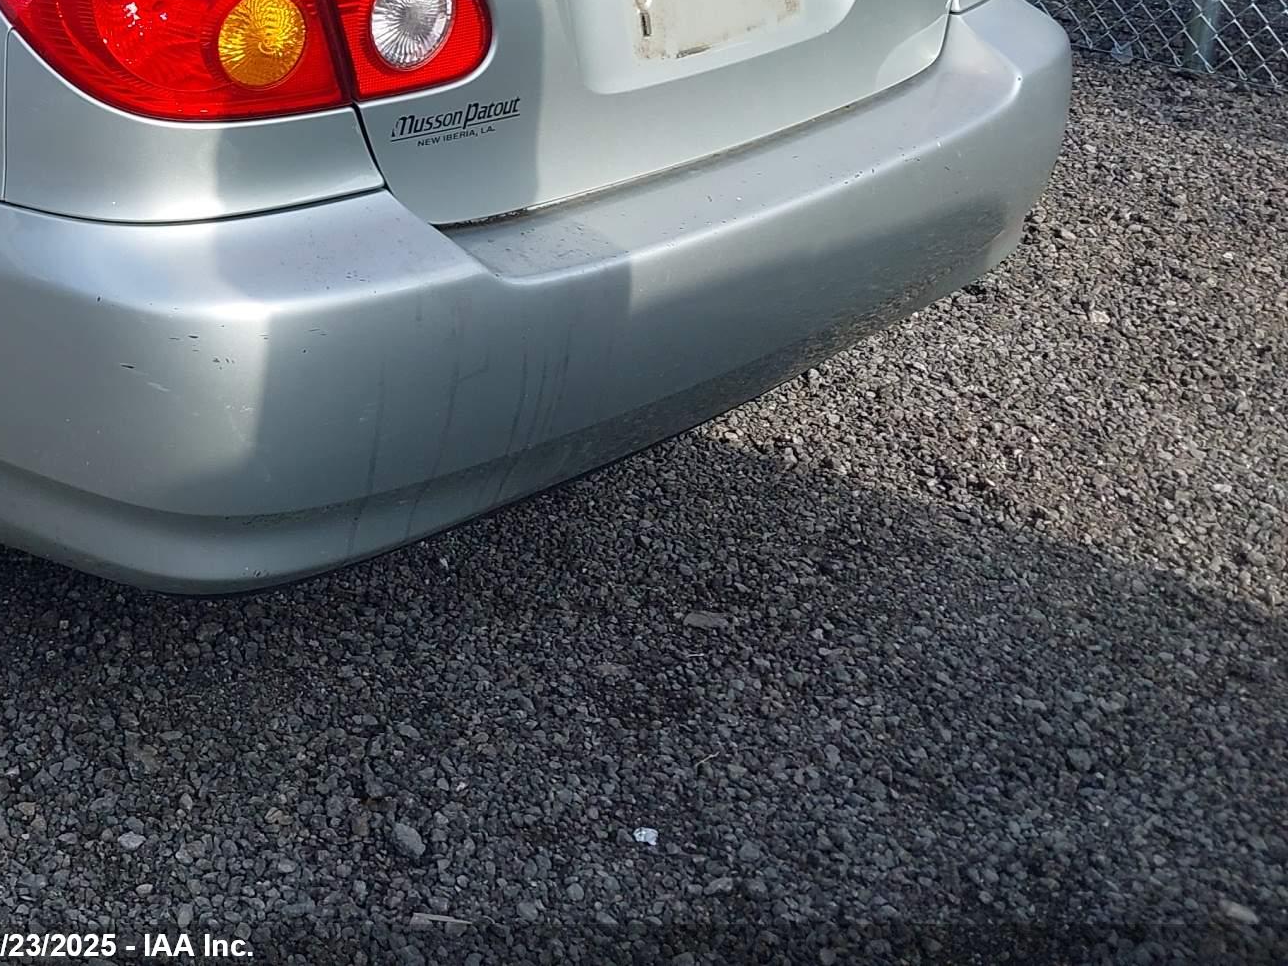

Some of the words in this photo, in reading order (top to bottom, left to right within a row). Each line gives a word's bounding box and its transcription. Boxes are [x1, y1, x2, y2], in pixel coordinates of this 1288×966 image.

[391, 110, 463, 138] Musson
[462, 96, 521, 130] Patout
[417, 136, 441, 147] NEW
[443, 129, 478, 142] IBERIA,
